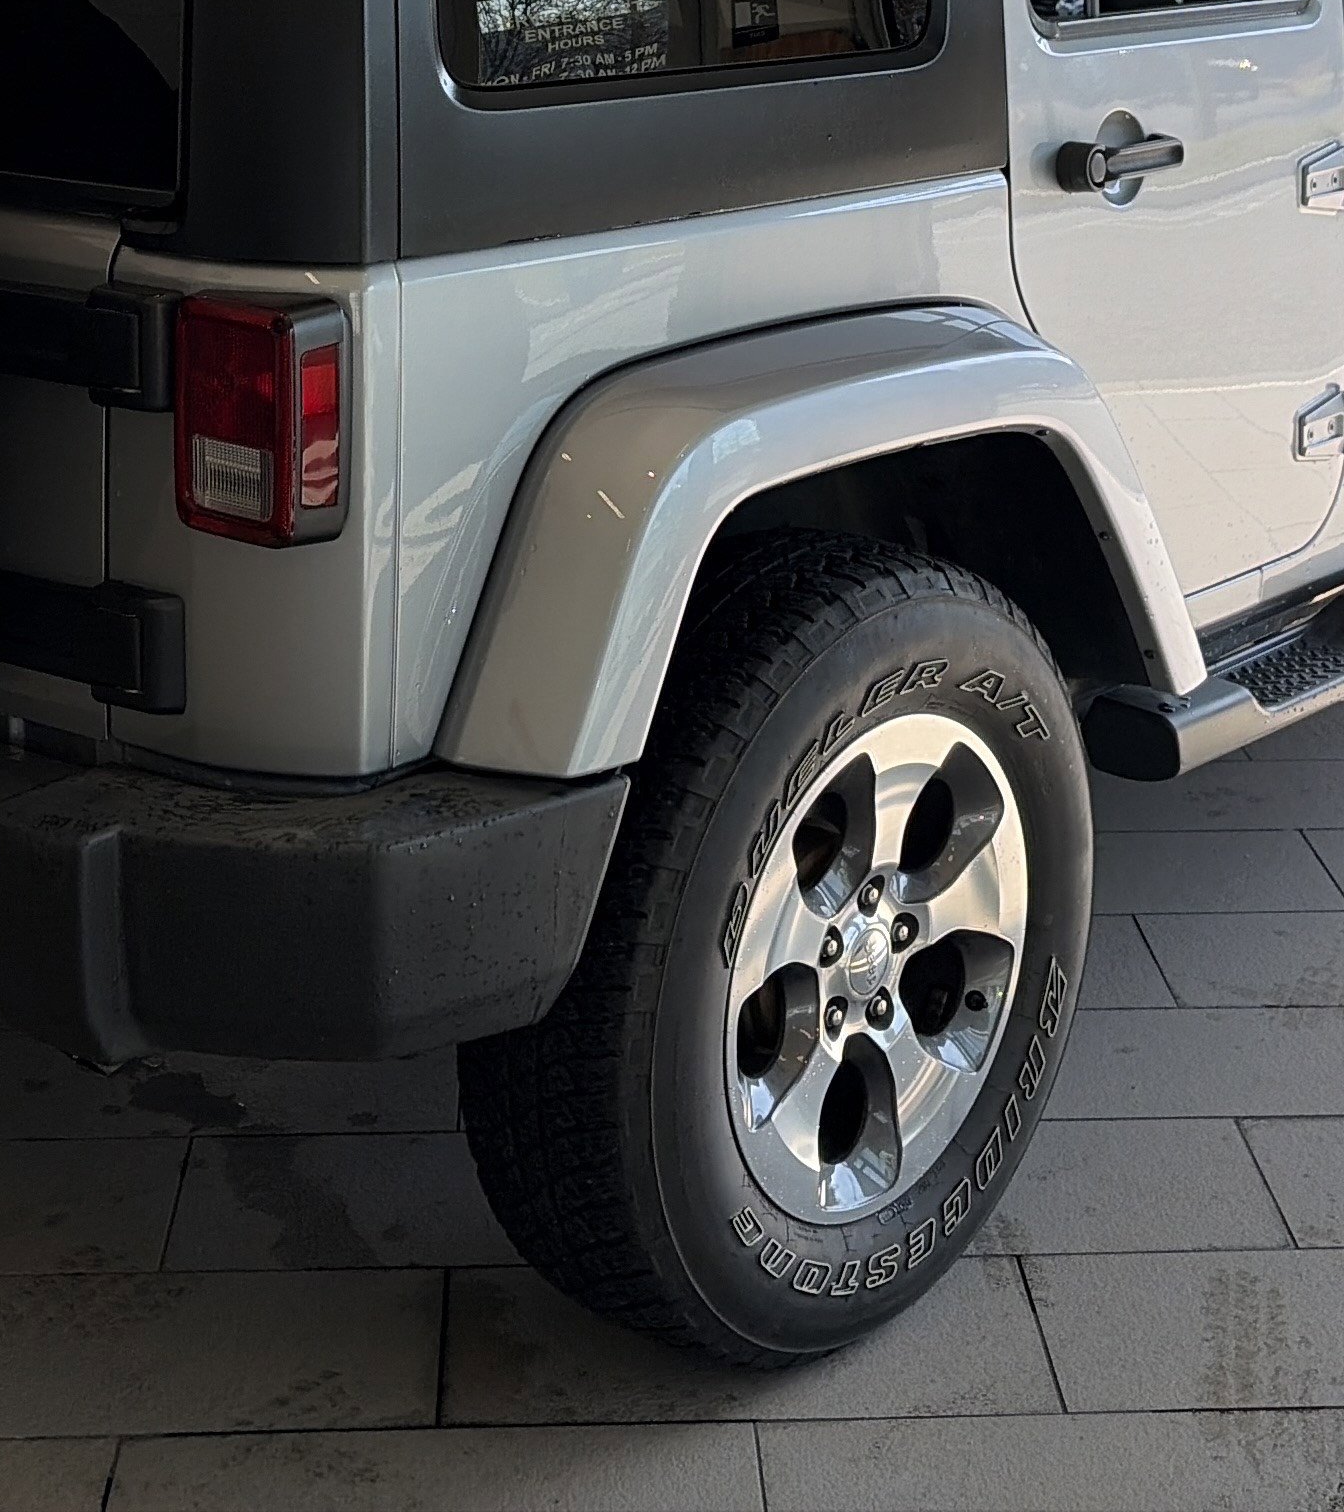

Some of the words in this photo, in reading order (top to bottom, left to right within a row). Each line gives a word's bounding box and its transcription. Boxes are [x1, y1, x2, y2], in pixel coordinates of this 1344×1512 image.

[524, 17, 625, 43] ENTRANCE
[547, 35, 605, 53] HOURS
[532, 61, 555, 80] FRI
[595, 51, 615, 66] AM
[624, 50, 632, 62] 5
[634, 43, 658, 59] PM
[641, 53, 666, 70] PM
[724, 658, 949, 970] DUELER
[959, 670, 1050, 740] A/T
[731, 954, 1068, 1295] BRIDGESTONE
